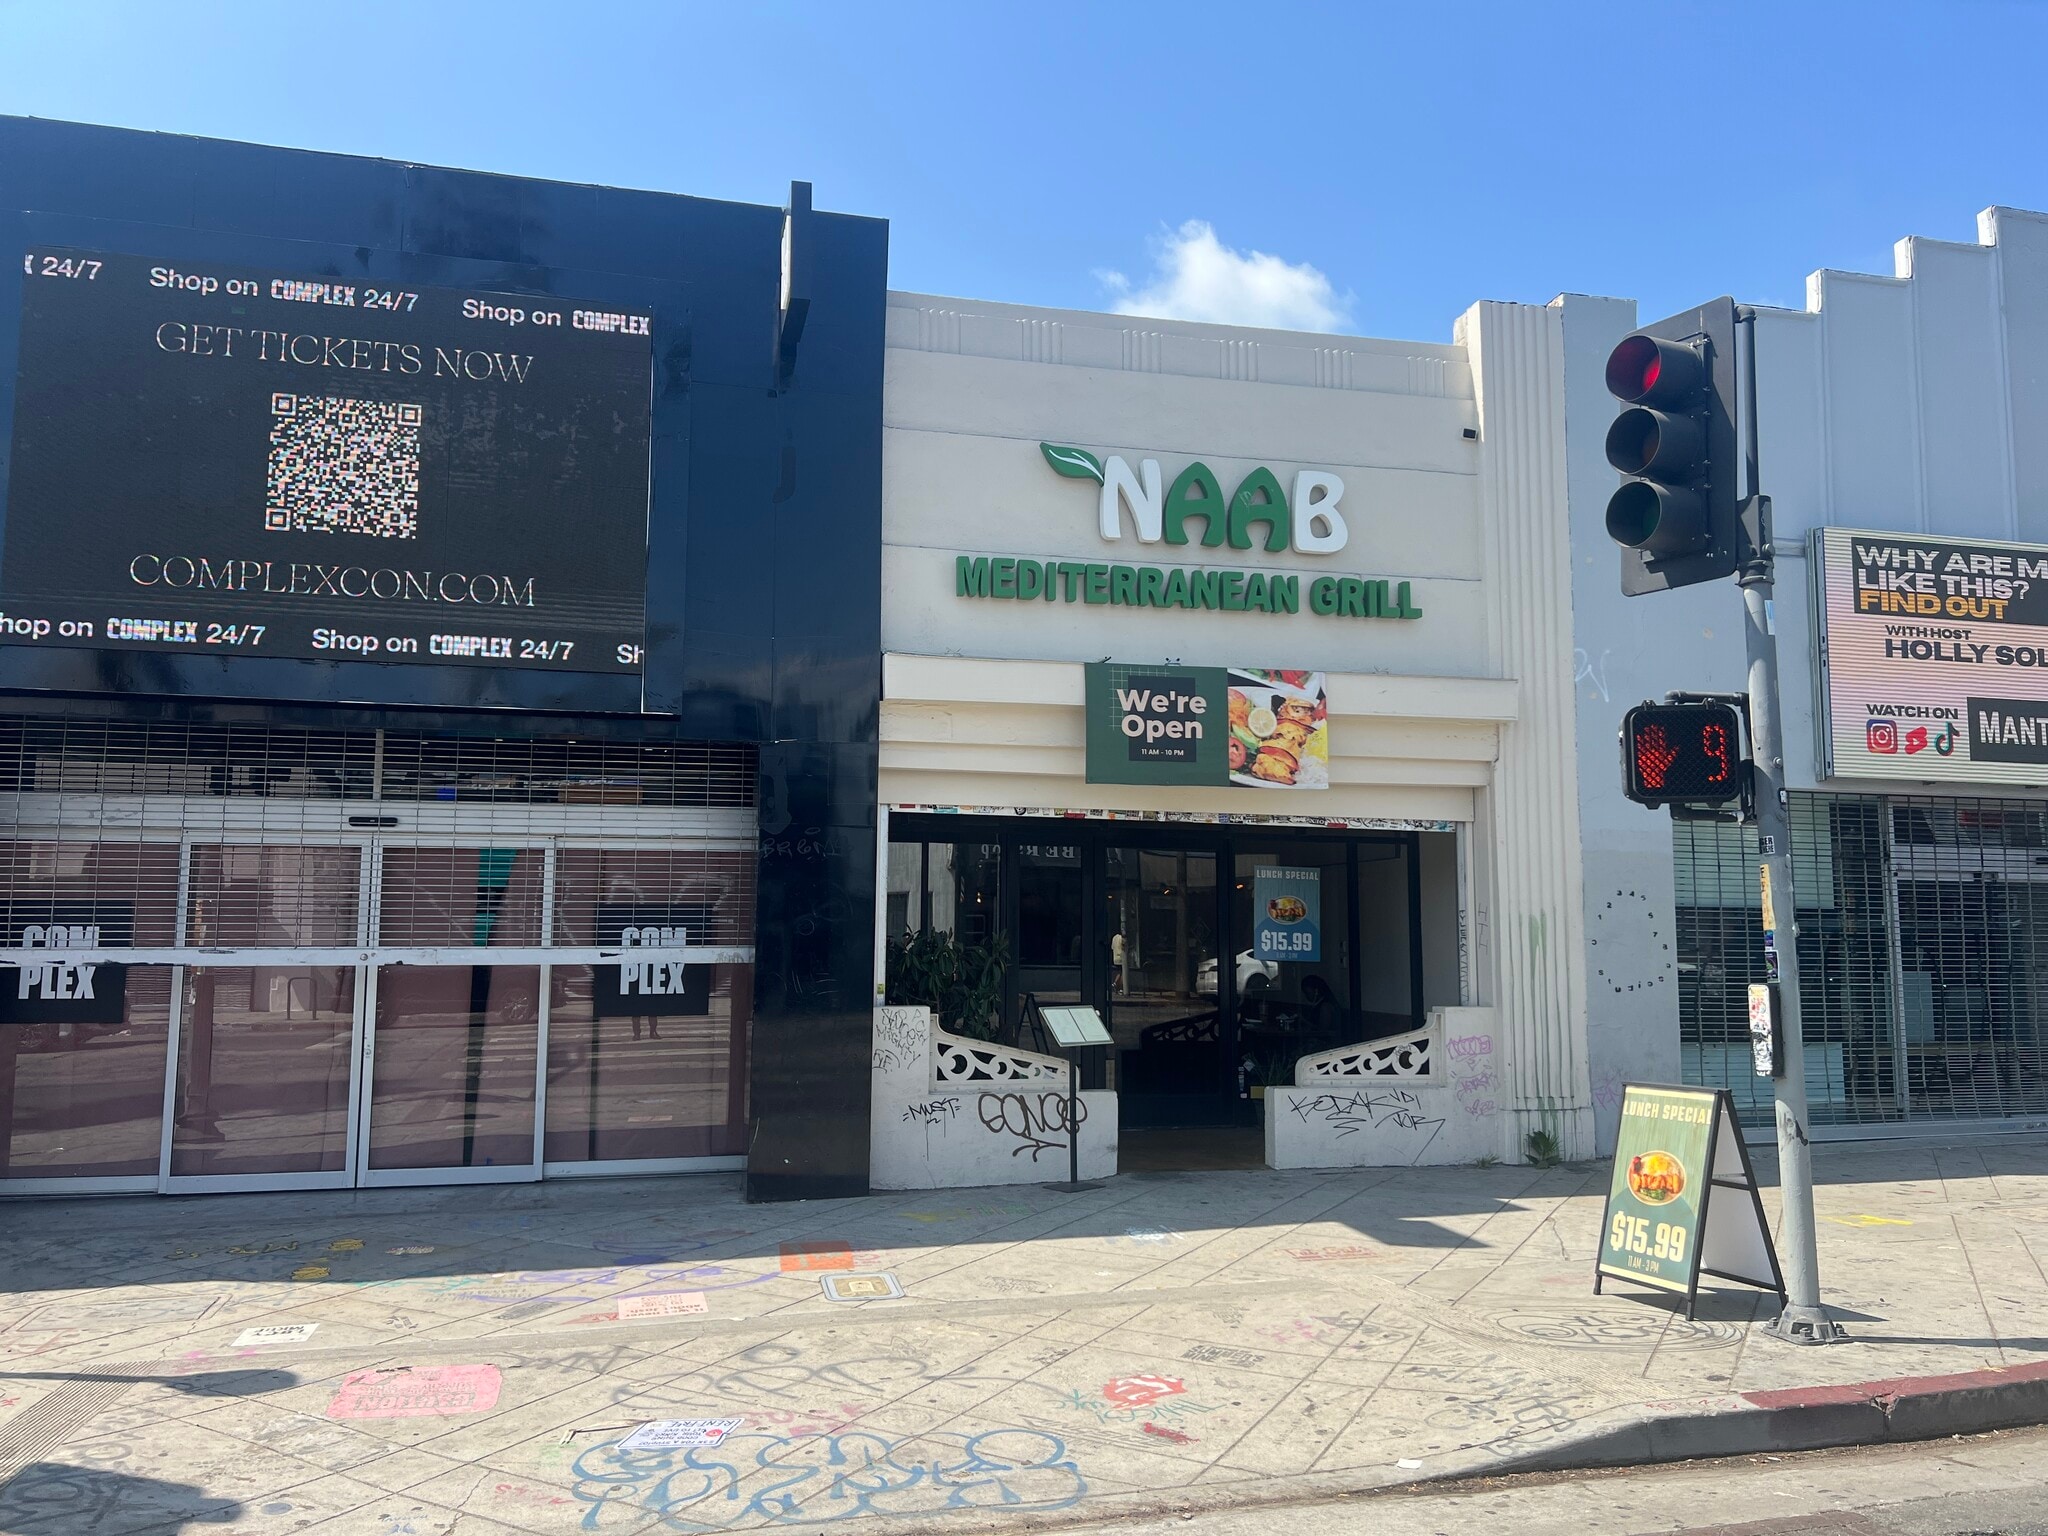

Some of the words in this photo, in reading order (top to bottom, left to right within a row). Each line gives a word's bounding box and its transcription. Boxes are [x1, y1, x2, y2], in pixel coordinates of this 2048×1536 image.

[41, 256, 102, 280] 24/7
[150, 267, 218, 295] Shop
[226, 279, 258, 296] on
[271, 279, 355, 307] COMPLEX
[363, 289, 419, 312] 24/7
[462, 298, 525, 326] Shop
[532, 311, 561, 326] on
[573, 310, 650, 336] COMPLEX
[156, 321, 242, 357] GET
[251, 330, 422, 375] TICKETS
[433, 347, 534, 384] NOW
[1099, 455, 1349, 555] NAAB
[1855, 545, 1940, 571] WHY
[1944, 553, 2014, 577] ARE
[130, 554, 535, 607] COMPLEXCON.COM
[955, 555, 1300, 615] MEDITERRANEAN
[1309, 576, 1423, 620] GRILL
[1858, 569, 1936, 594] LIKE
[1941, 574, 2030, 600] THIS?
[1859, 589, 1941, 615] FIND
[1946, 596, 2008, 619] OUT
[58, 619, 94, 639] on
[107, 617, 198, 643] COMPLEX
[205, 623, 266, 646] 24/7
[312, 628, 378, 655] Shop
[386, 635, 417, 653] on
[429, 634, 512, 658] COMPLEX
[520, 640, 574, 661] 24/7
[1885, 625, 1928, 638] WITH
[1930, 628, 1971, 640] HOST
[1885, 638, 1990, 664] HOLLY
[1116, 689, 1207, 714] We're
[1866, 703, 1930, 718] WATCH
[1932, 706, 1959, 719] ON
[1121, 714, 1203, 743] Open
[1141, 748, 1148, 756] 11
[1148, 748, 1160, 756] AM
[1173, 749, 1184, 757] PM
[1703, 725, 1729, 783] 9
[1257, 869, 1283, 879] LUNCH
[1285, 871, 1319, 880] SPECIAL
[1261, 929, 1312, 952] $15.99
[18, 965, 97, 1000] PLEX
[620, 963, 685, 995] PLEX
[1623, 1101, 1659, 1119] LUNCH
[1662, 1105, 1711, 1125] SPECIAL
[1610, 1211, 1687, 1264] $15.99
[1632, 1257, 1641, 1270] AM
[1650, 1259, 1660, 1274] PM
